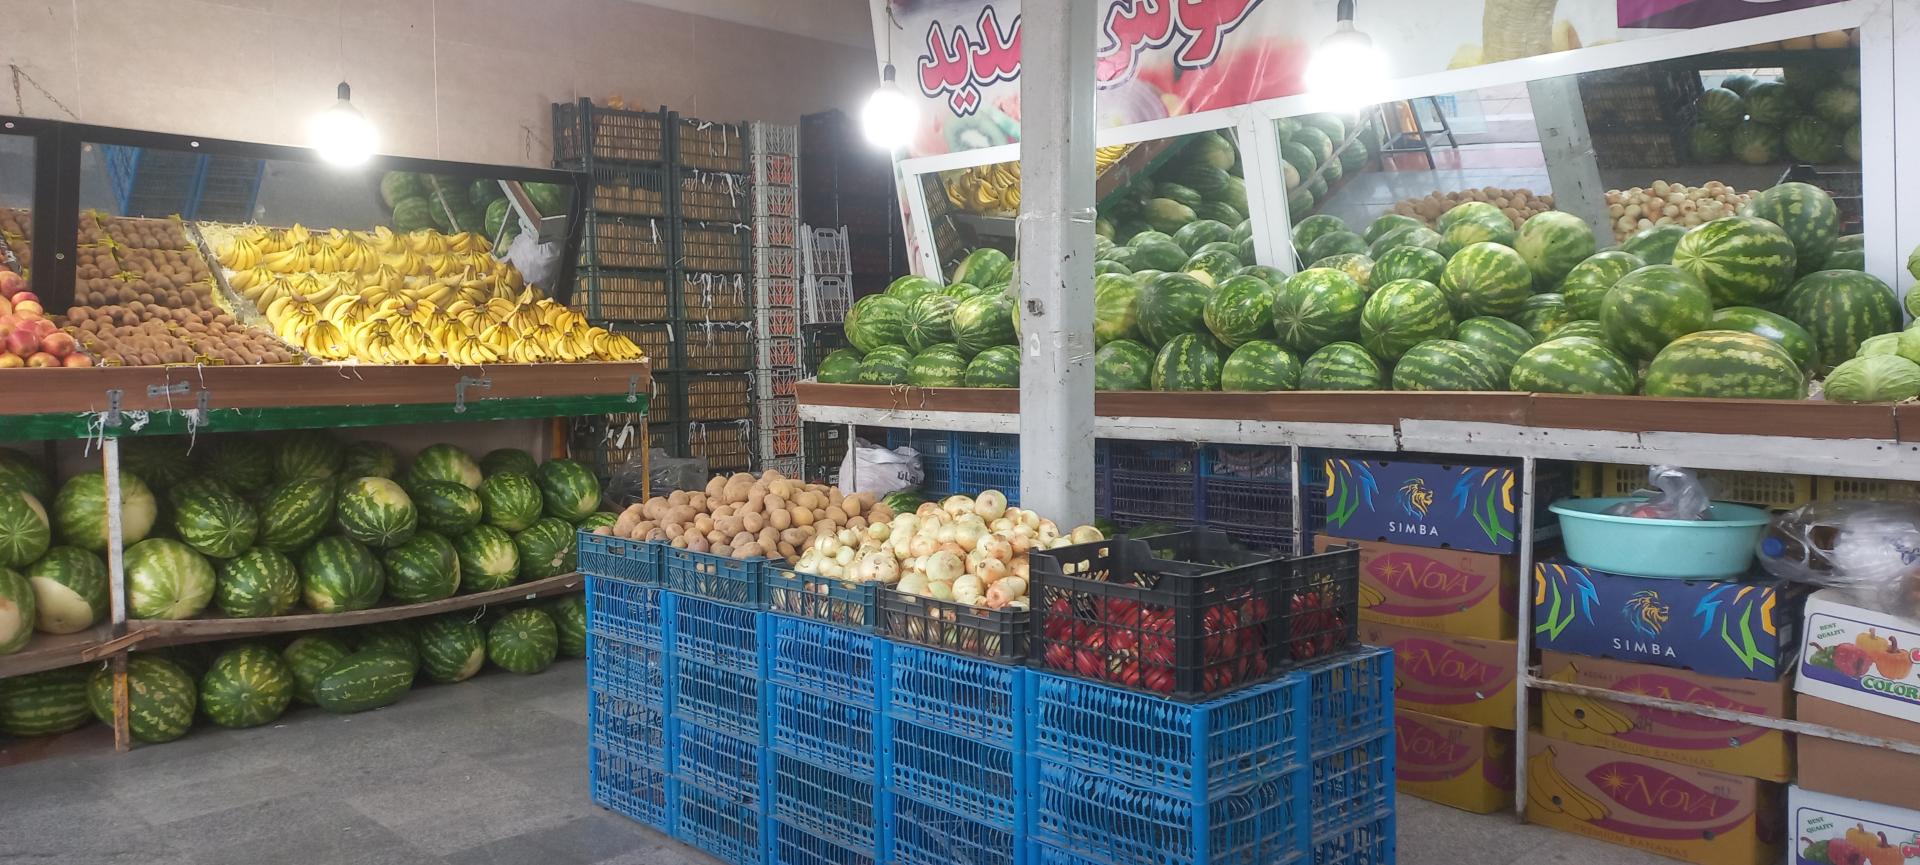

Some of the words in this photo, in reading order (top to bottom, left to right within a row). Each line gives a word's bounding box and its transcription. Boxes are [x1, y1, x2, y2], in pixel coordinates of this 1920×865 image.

[1388, 521, 1439, 537] SIMBA
[1819, 622, 1837, 631] BEST
[1816, 628, 1846, 640] QUALITY
[1612, 638, 1677, 658] SIMBA
[1807, 816, 1825, 825] BEST
[1806, 822, 1835, 834] QUALITY
[1629, 836, 1690, 858] BANANAS
